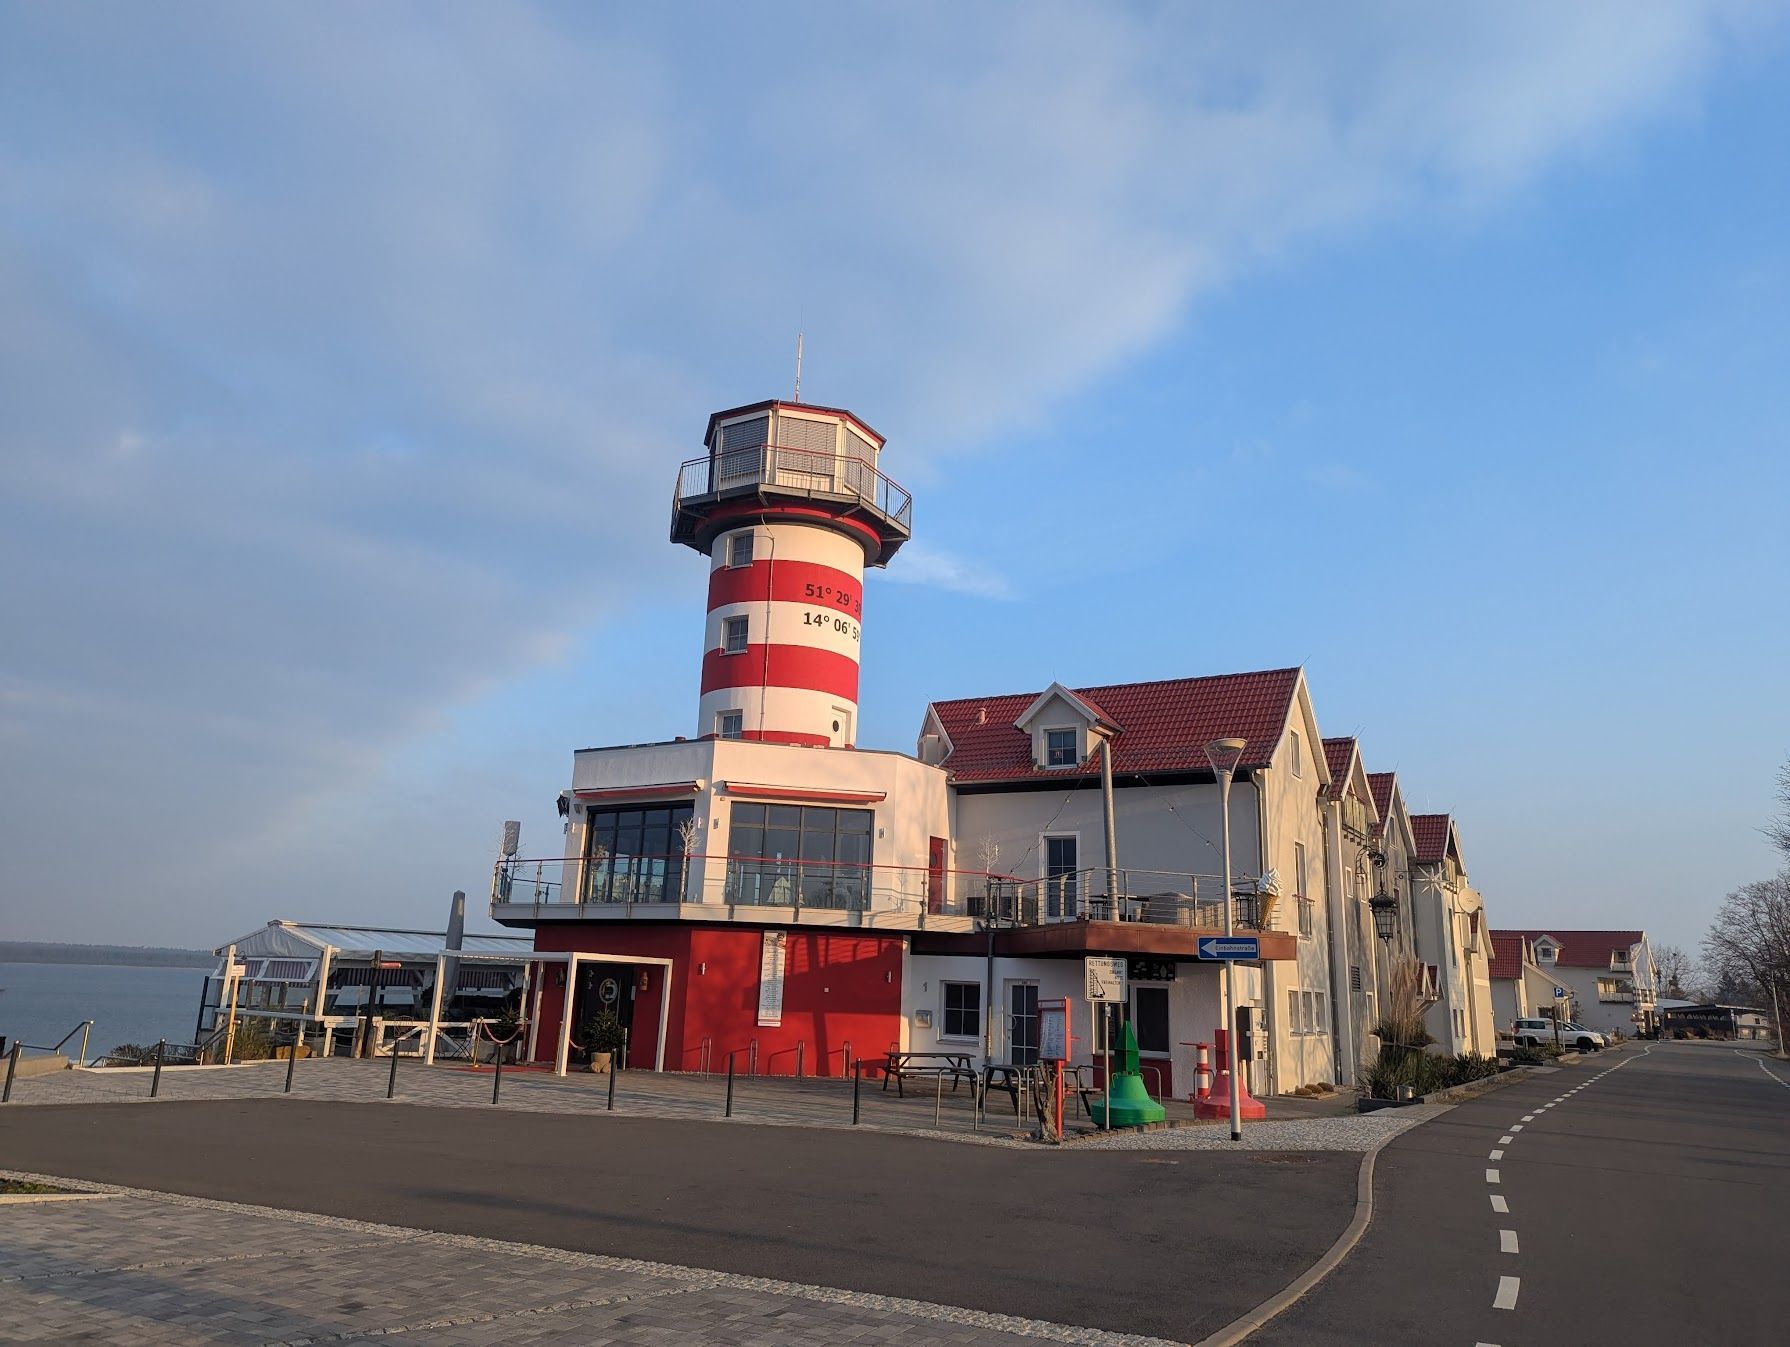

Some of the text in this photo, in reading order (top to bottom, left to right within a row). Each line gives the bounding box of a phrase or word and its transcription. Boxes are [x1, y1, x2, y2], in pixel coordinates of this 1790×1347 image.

[805, 584, 831, 599] 51°
[804, 612, 829, 627] 14°
[1556, 988, 1562, 997] P
